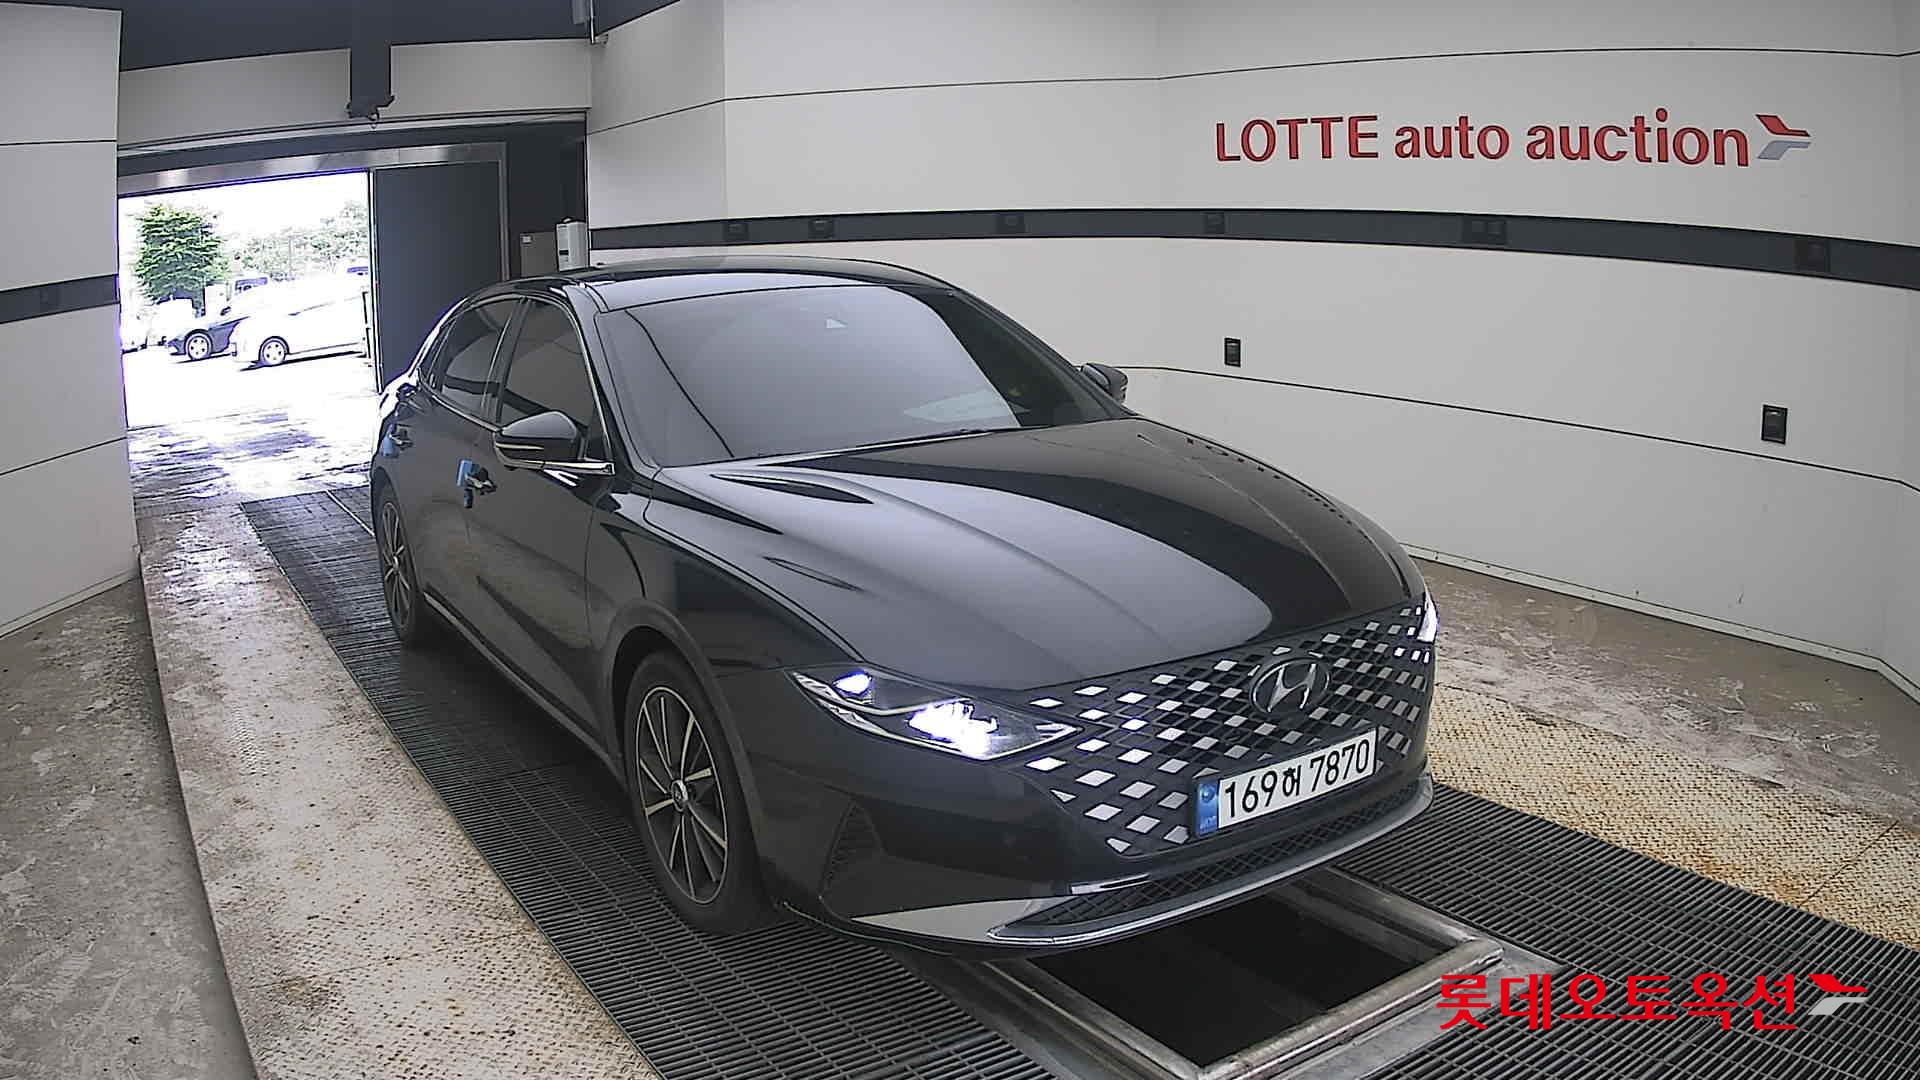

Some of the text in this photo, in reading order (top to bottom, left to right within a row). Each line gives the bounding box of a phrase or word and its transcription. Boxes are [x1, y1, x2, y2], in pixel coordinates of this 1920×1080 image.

[1215, 107, 1750, 168] LOTTE auto auction
[1225, 739, 1370, 818] 169허 7870
